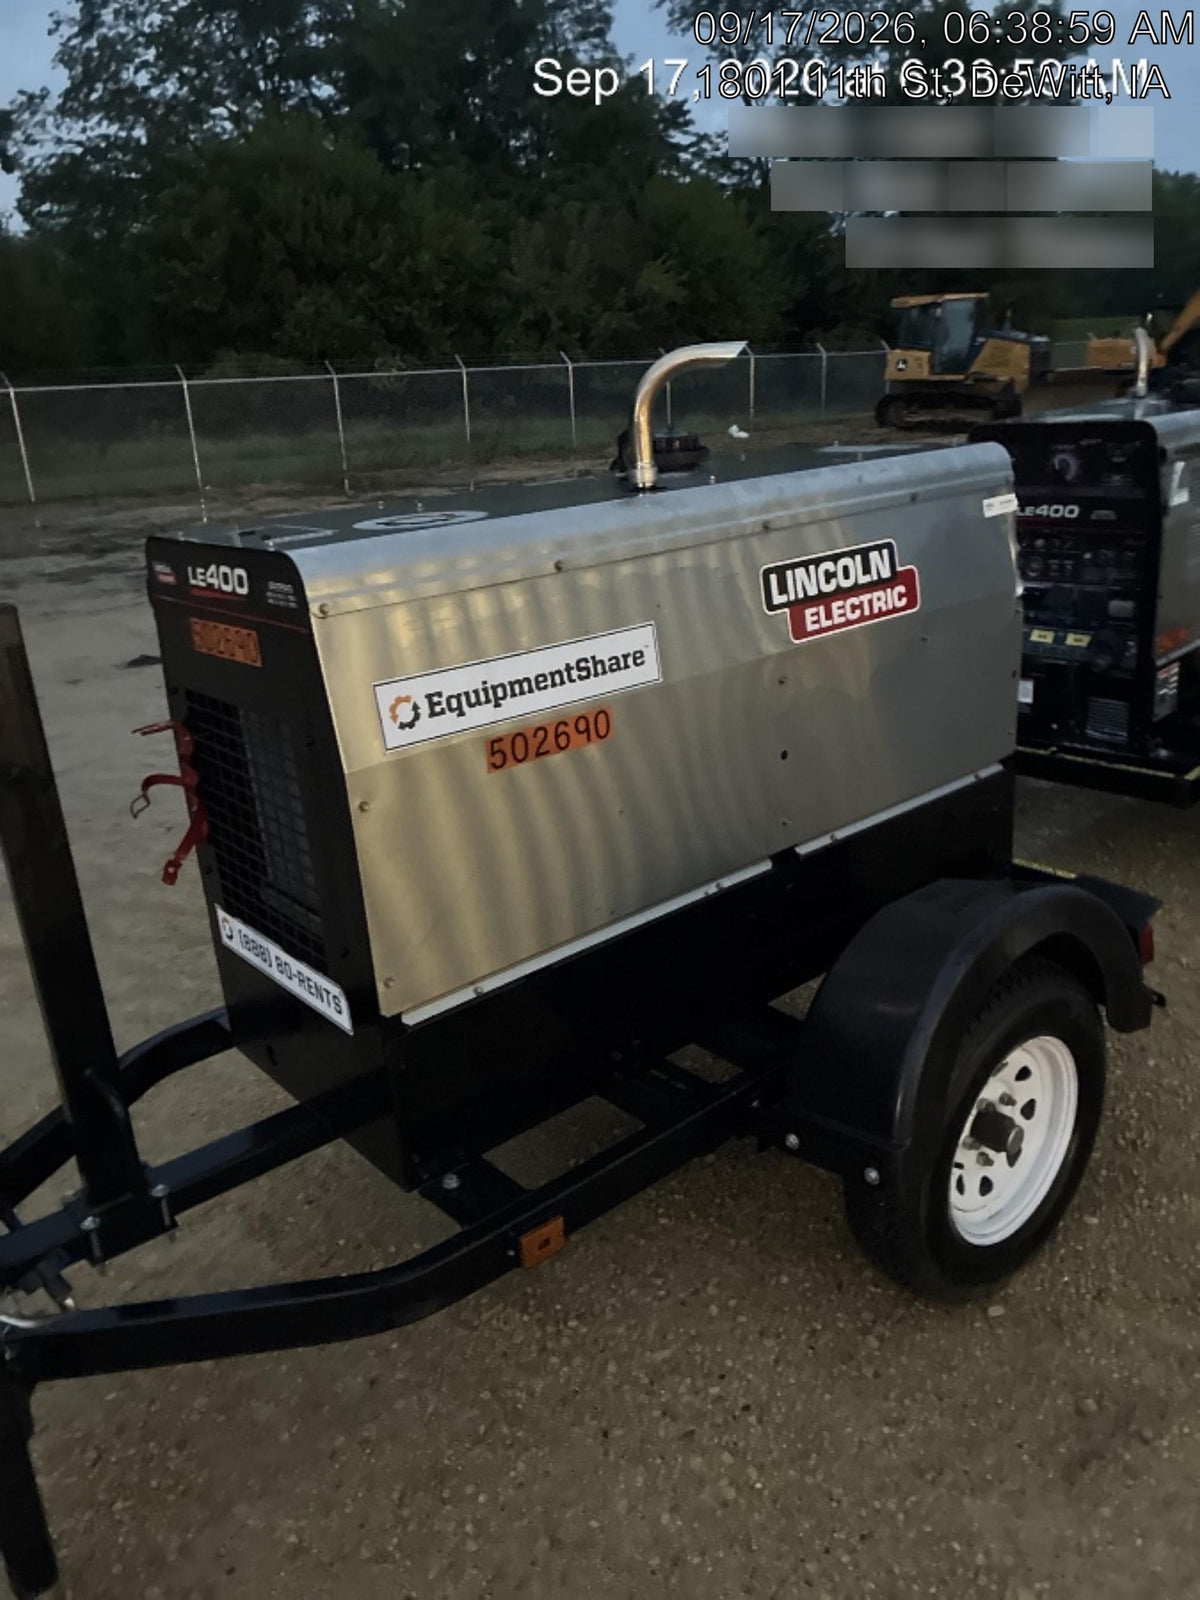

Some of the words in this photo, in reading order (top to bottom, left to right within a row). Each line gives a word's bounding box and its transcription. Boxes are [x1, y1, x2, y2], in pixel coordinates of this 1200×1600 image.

[187, 564, 250, 596] LE400
[768, 548, 893, 606] LINCOLN
[803, 584, 908, 633] ELECTRIC
[424, 648, 647, 719] EquipmentShare
[489, 709, 612, 771] 502690
